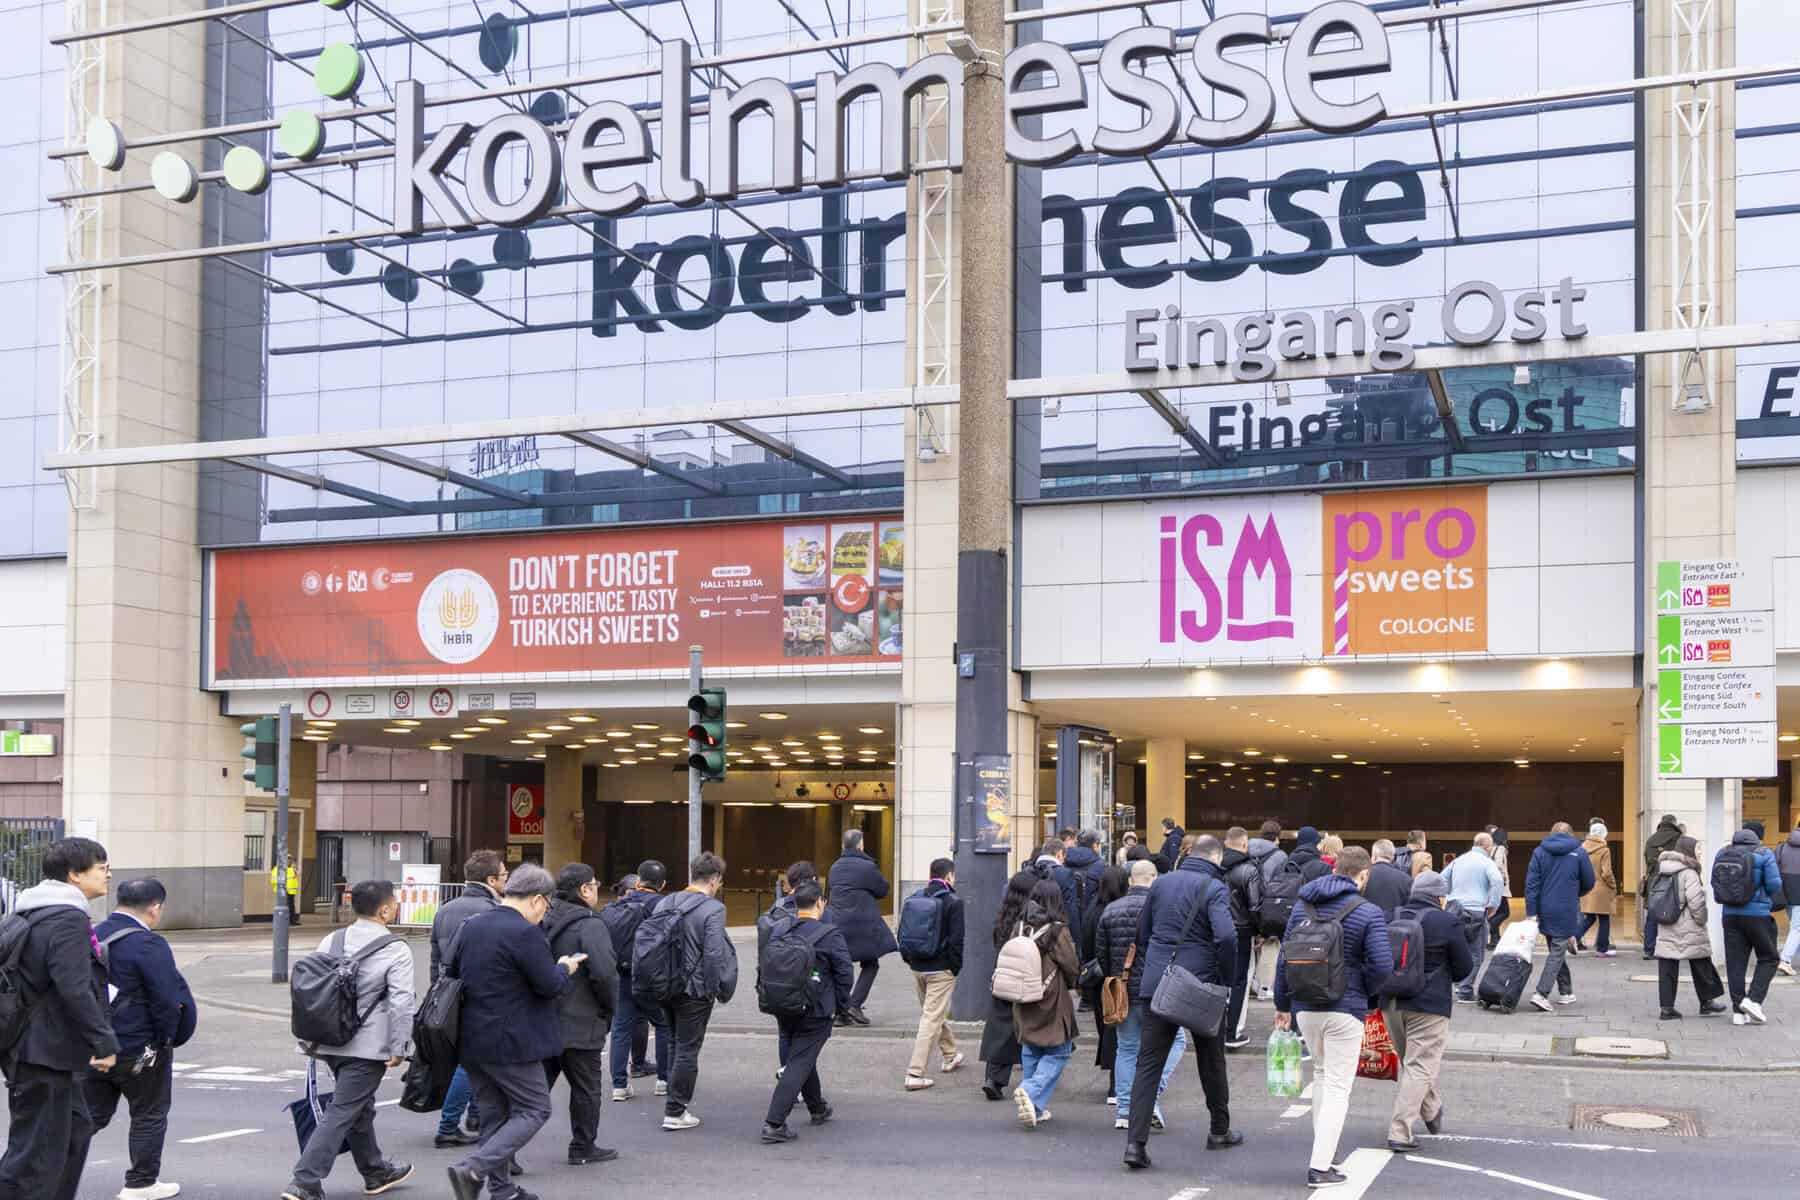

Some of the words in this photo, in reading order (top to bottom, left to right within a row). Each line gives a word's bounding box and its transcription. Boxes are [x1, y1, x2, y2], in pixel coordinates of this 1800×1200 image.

[394, 0, 1391, 237] koelnmesse
[1125, 300, 1415, 383] Eingang
[1441, 276, 1588, 346] Ost
[1469, 386, 1583, 438] Ost
[1334, 507, 1476, 584] pro
[509, 554, 580, 591] DON'T
[586, 550, 679, 588] FORGET
[1683, 563, 1715, 573] Eingang
[1717, 562, 1732, 570] Ost
[1350, 562, 1474, 593] sweets
[1682, 573, 1719, 582] Entrance
[510, 593, 528, 616] TO
[532, 589, 625, 615] EXPERIENCE
[629, 588, 678, 612] TASTY
[1378, 616, 1475, 635] COLOGNE
[1683, 618, 1716, 628] Eingang
[1718, 617, 1740, 625] West
[510, 616, 593, 647] TURKISH
[598, 613, 680, 644] SWEETS
[1684, 628, 1719, 637] Entrance
[1721, 627, 1742, 635] West
[1683, 673, 1715, 682] Eingang
[1717, 672, 1746, 680] Confex
[1683, 682, 1721, 691] Entrance
[1722, 681, 1752, 690] Confex
[1683, 692, 1715, 701] Eingang
[1717, 691, 1733, 700] Süd
[1683, 702, 1721, 711] Entrance
[1722, 702, 1747, 710] South
[1684, 728, 1717, 737] Eingang
[1719, 727, 1740, 735] Nord
[1684, 738, 1721, 746] Entrance
[1722, 736, 1747, 745] North
